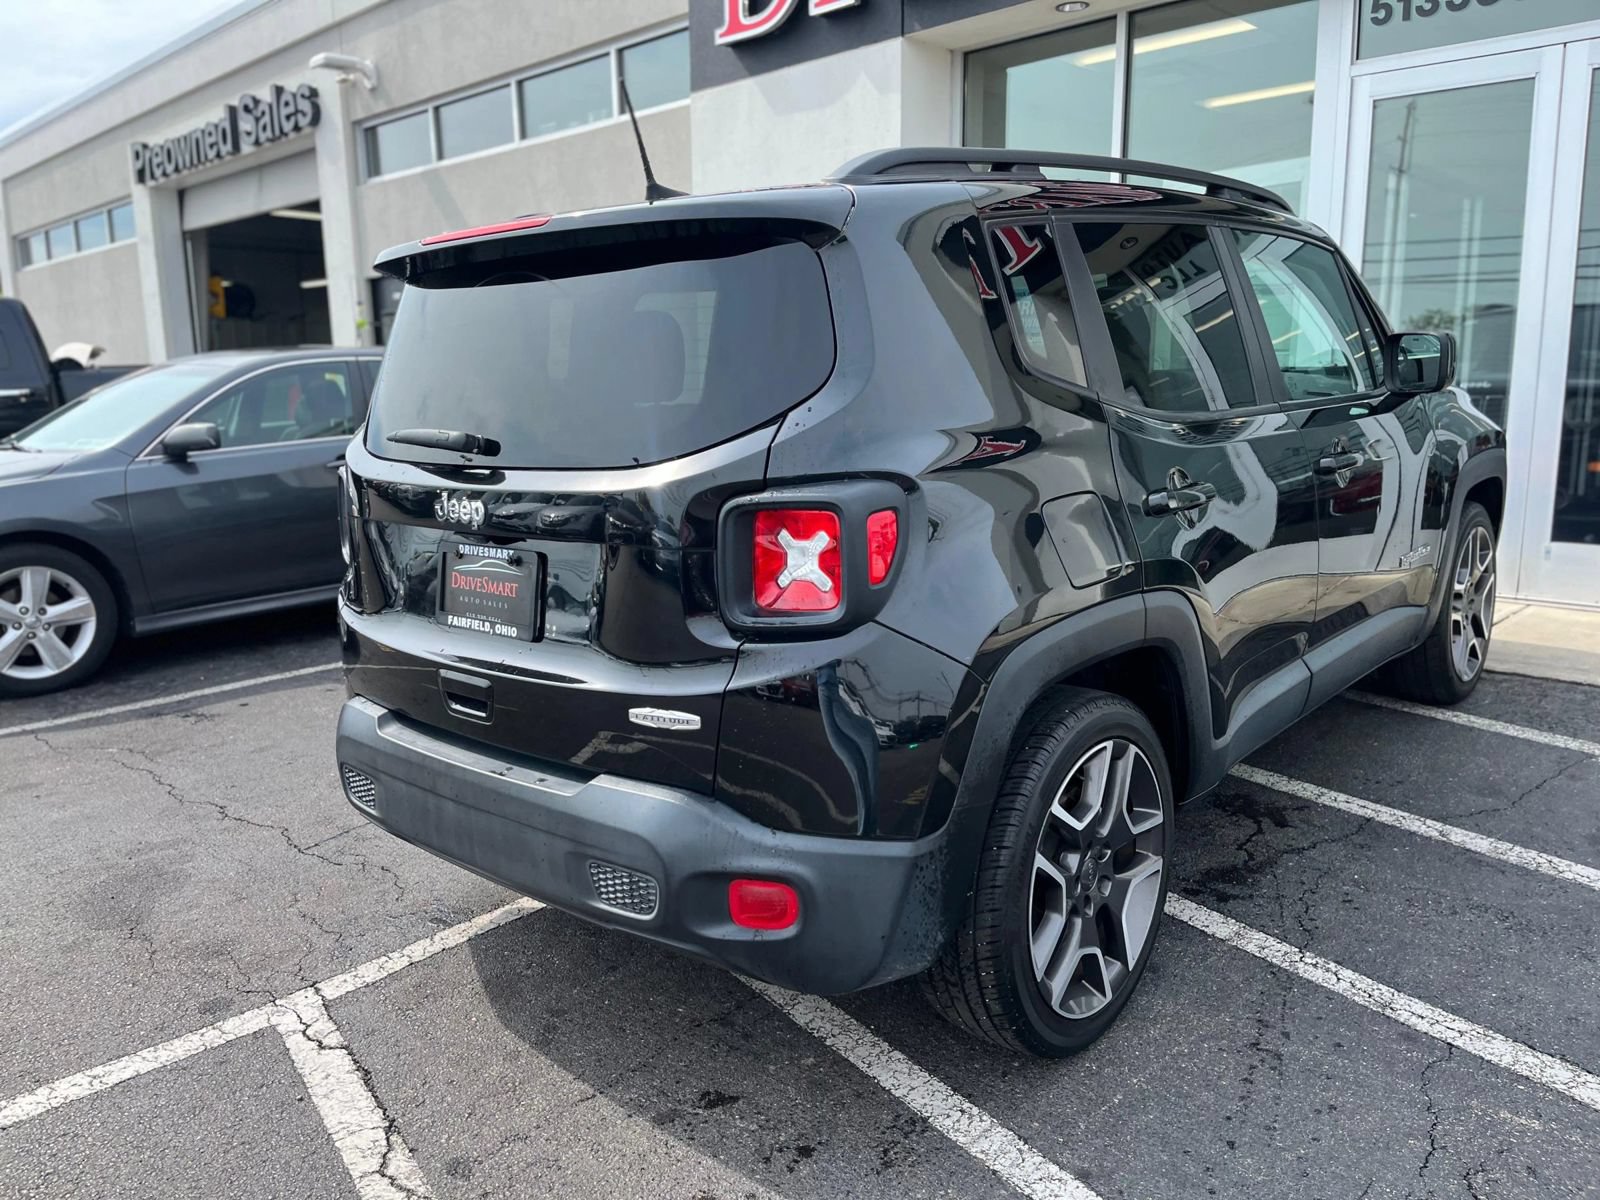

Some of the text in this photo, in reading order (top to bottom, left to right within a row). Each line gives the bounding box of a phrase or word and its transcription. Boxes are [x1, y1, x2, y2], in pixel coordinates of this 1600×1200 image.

[131, 83, 322, 185] Preowned Sales
[434, 491, 486, 530] Jeep
[458, 544, 515, 560] DRIVESMART
[459, 595, 508, 609] AUTO SALES
[447, 615, 493, 635] FAIRFIELD,
[495, 624, 518, 638] OHIO
